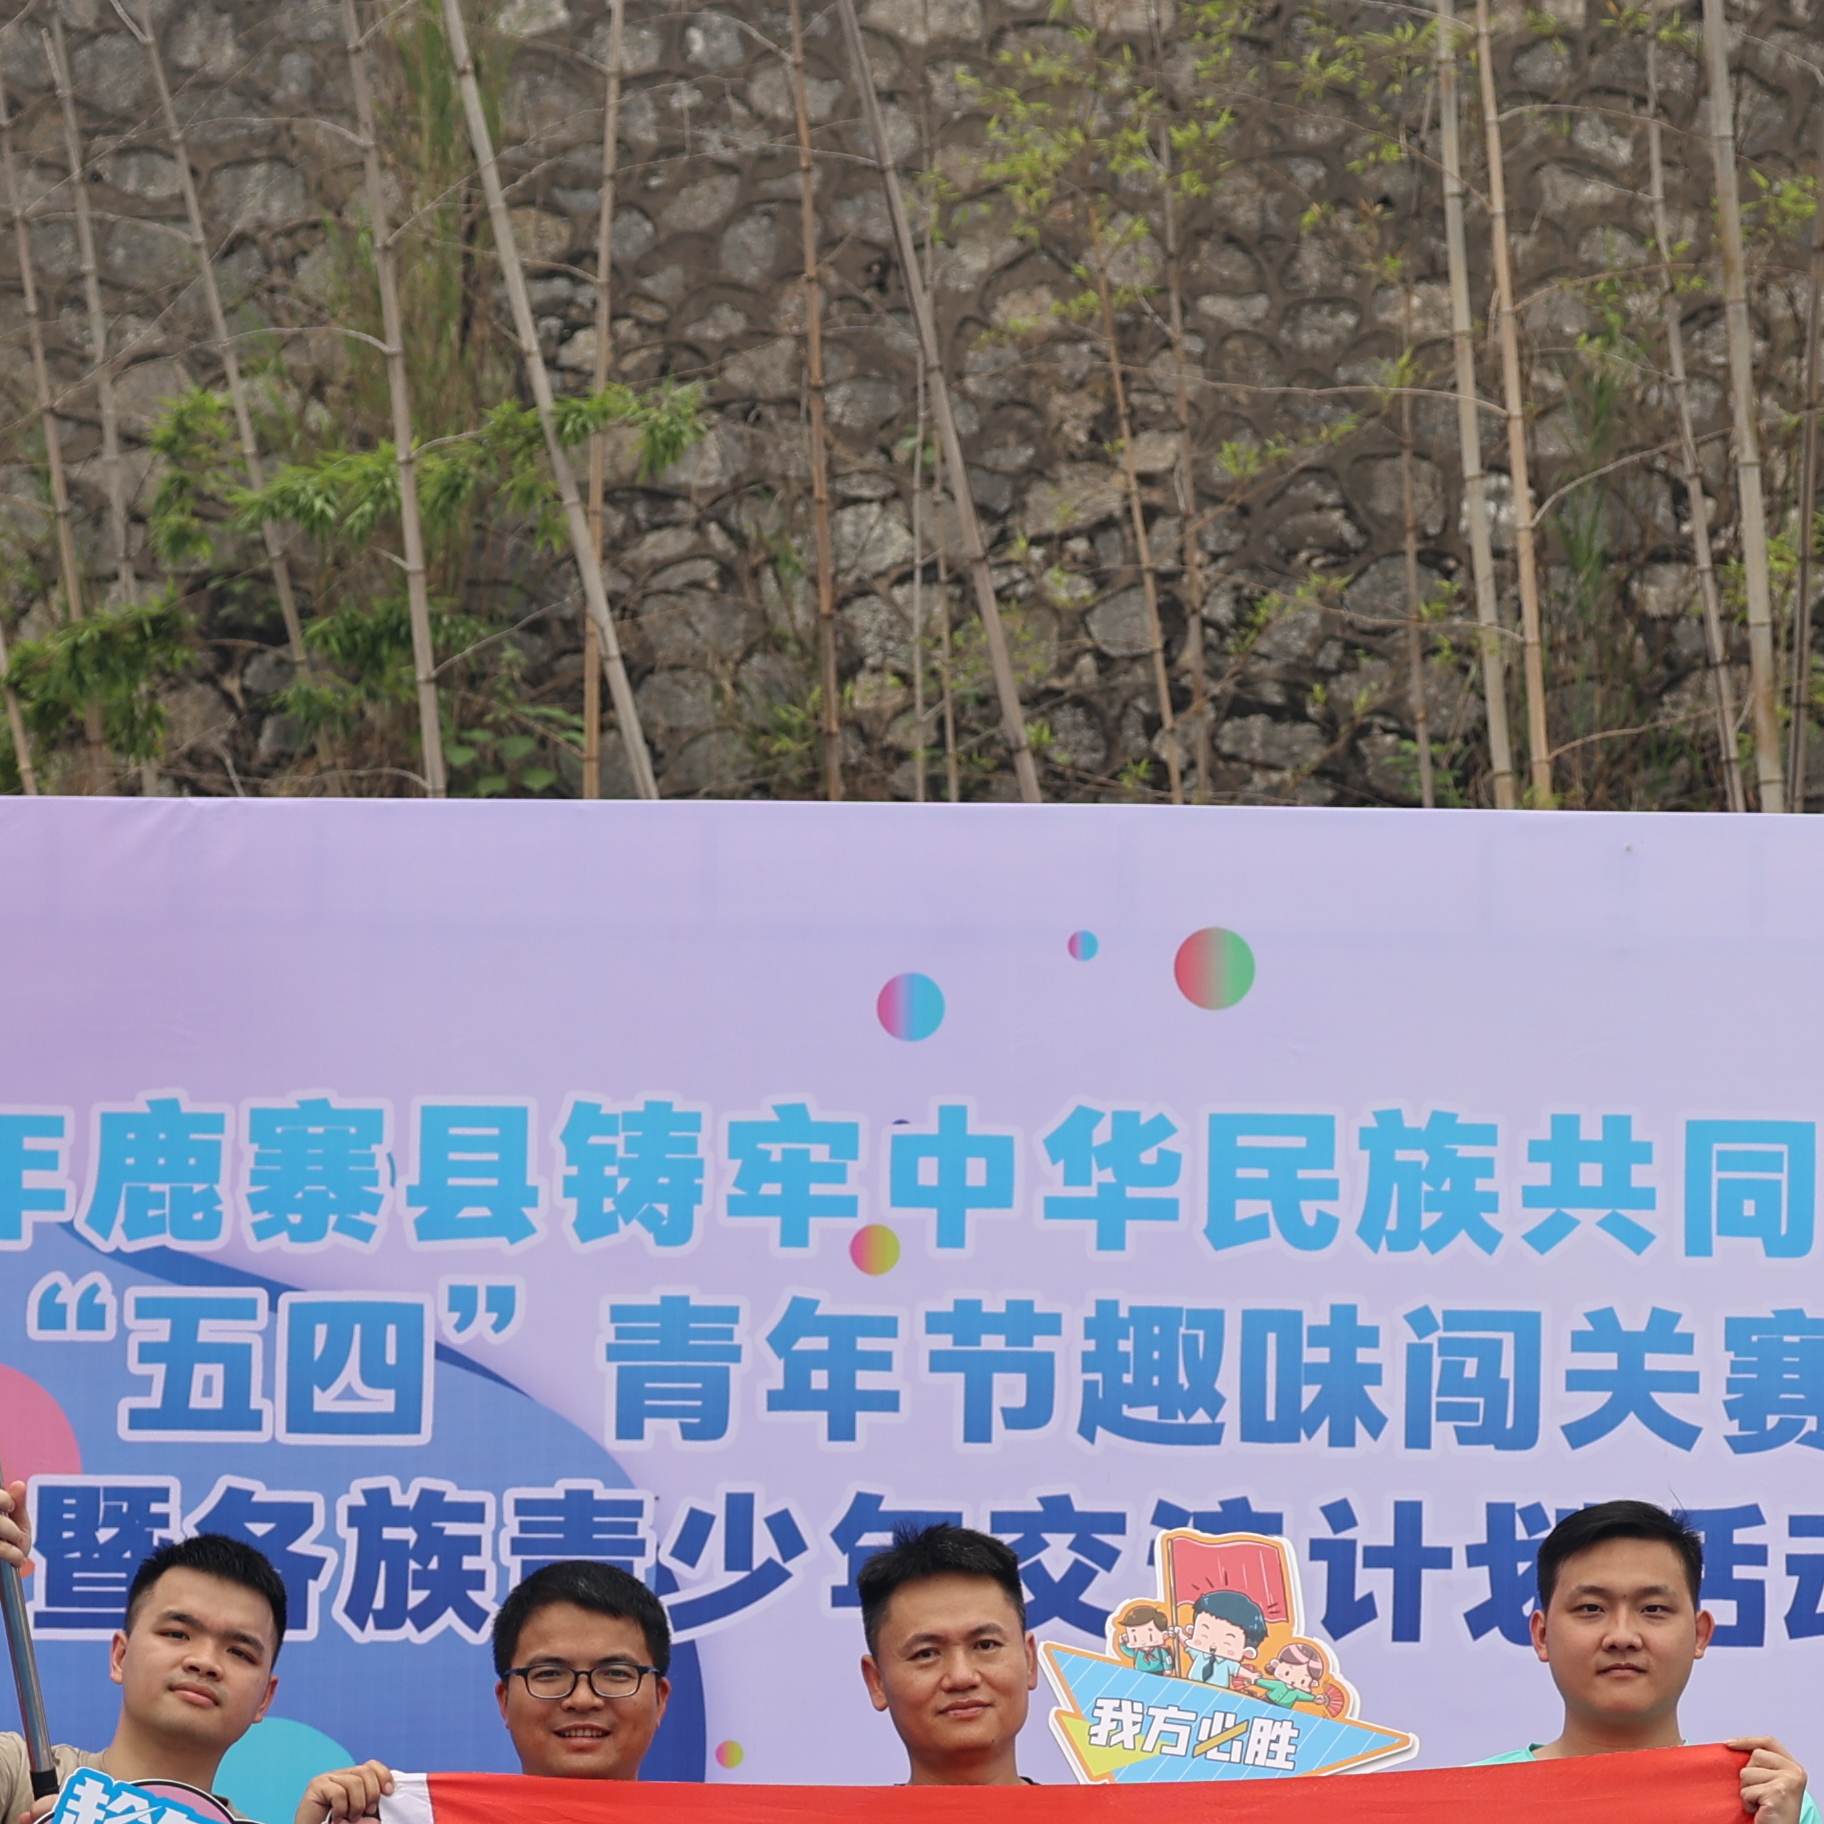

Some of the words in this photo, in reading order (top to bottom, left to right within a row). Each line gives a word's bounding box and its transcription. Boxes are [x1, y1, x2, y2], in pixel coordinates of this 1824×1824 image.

[36, 1282, 517, 1437] “五四”
[1088, 1697, 1301, 1772] 我方必胜
